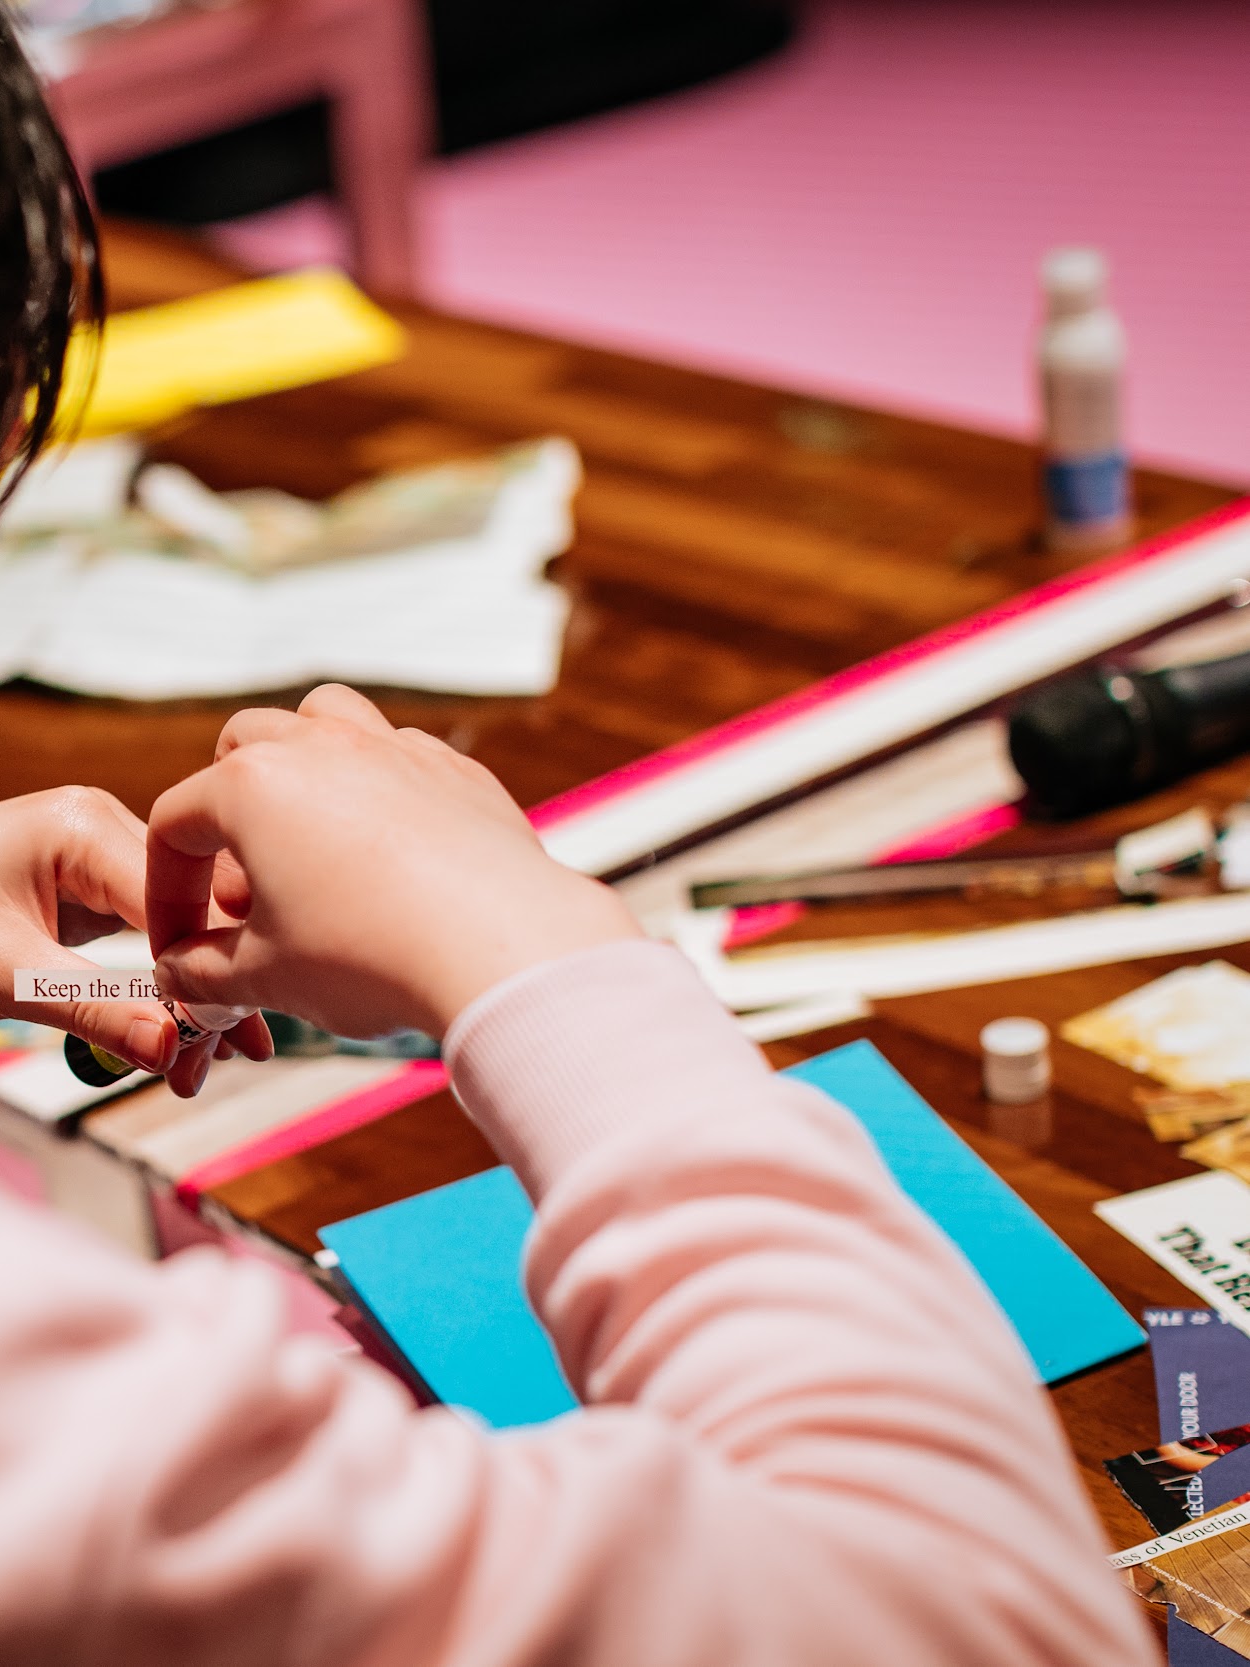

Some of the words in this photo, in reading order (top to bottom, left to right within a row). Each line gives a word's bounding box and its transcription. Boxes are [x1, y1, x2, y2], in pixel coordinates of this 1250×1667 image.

[33, 978, 81, 1001] Keep
[89, 978, 120, 998] the
[1158, 1226, 1229, 1275] That
[1178, 1372, 1199, 1406] DOOR
[1145, 1541, 1165, 1555] of
[1168, 1512, 1248, 1543] Venetian
